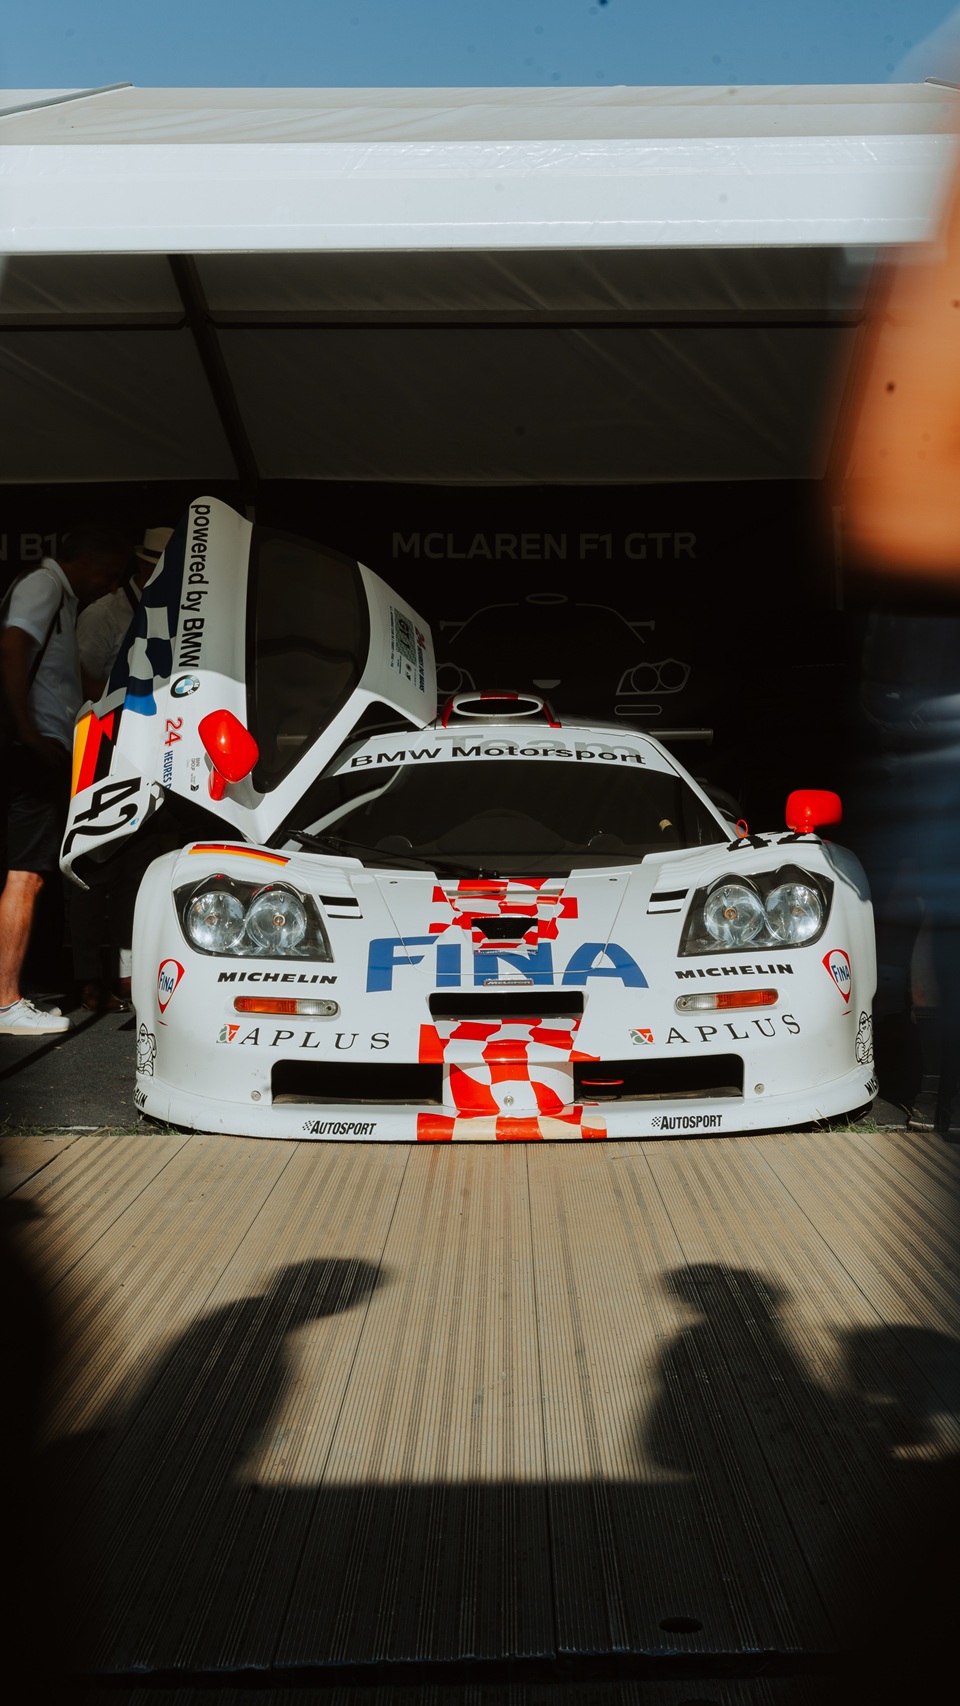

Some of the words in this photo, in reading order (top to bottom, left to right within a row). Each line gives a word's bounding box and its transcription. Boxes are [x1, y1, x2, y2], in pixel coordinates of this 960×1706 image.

[20, 532, 71, 560] B1
[190, 503, 211, 585] powered
[391, 532, 567, 560] MCLAREN
[579, 532, 613, 560] F1
[624, 532, 697, 560] GTR
[181, 591, 207, 614] by
[178, 617, 205, 667] BMW
[164, 717, 183, 747] 24
[350, 747, 442, 768] BMW
[452, 746, 646, 765] Motorsport
[434, 734, 641, 760] Team
[163, 750, 174, 783] HEURES
[61, 776, 142, 859] 42
[366, 935, 649, 993] FINA
[675, 963, 794, 979] MICHELIN
[831, 964, 850, 983] FINA
[158, 971, 175, 994] FINA
[217, 972, 338, 985] MICHELIN
[310, 1120, 377, 1136] AUTOSPORT
[660, 1114, 723, 1131] AUTOSPORT
